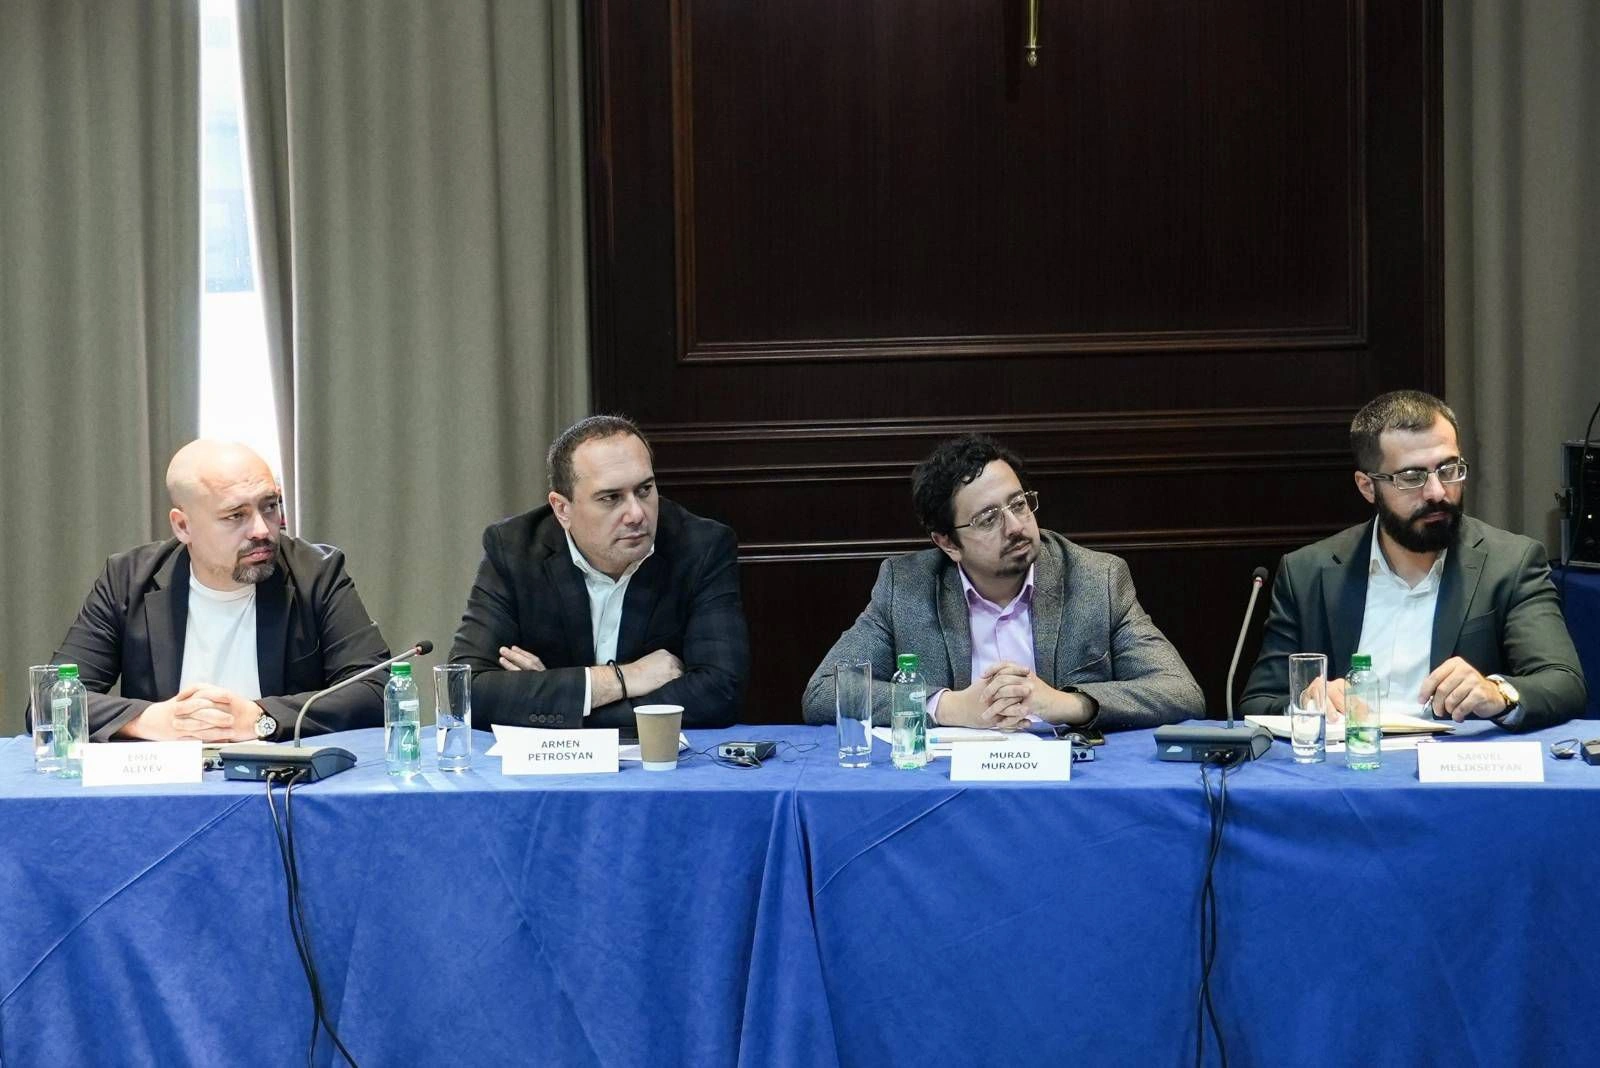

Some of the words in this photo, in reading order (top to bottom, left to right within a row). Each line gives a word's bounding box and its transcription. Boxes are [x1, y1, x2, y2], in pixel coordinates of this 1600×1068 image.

[541, 739, 581, 749] ARMEN
[528, 752, 593, 761] PETROSYAN
[989, 751, 1031, 759] MURAD
[1456, 752, 1504, 761] SAMVEL
[122, 764, 163, 774] ALIYEV
[981, 762, 1038, 770] MURADOV
[1440, 763, 1522, 772] MELIKSETYAN
